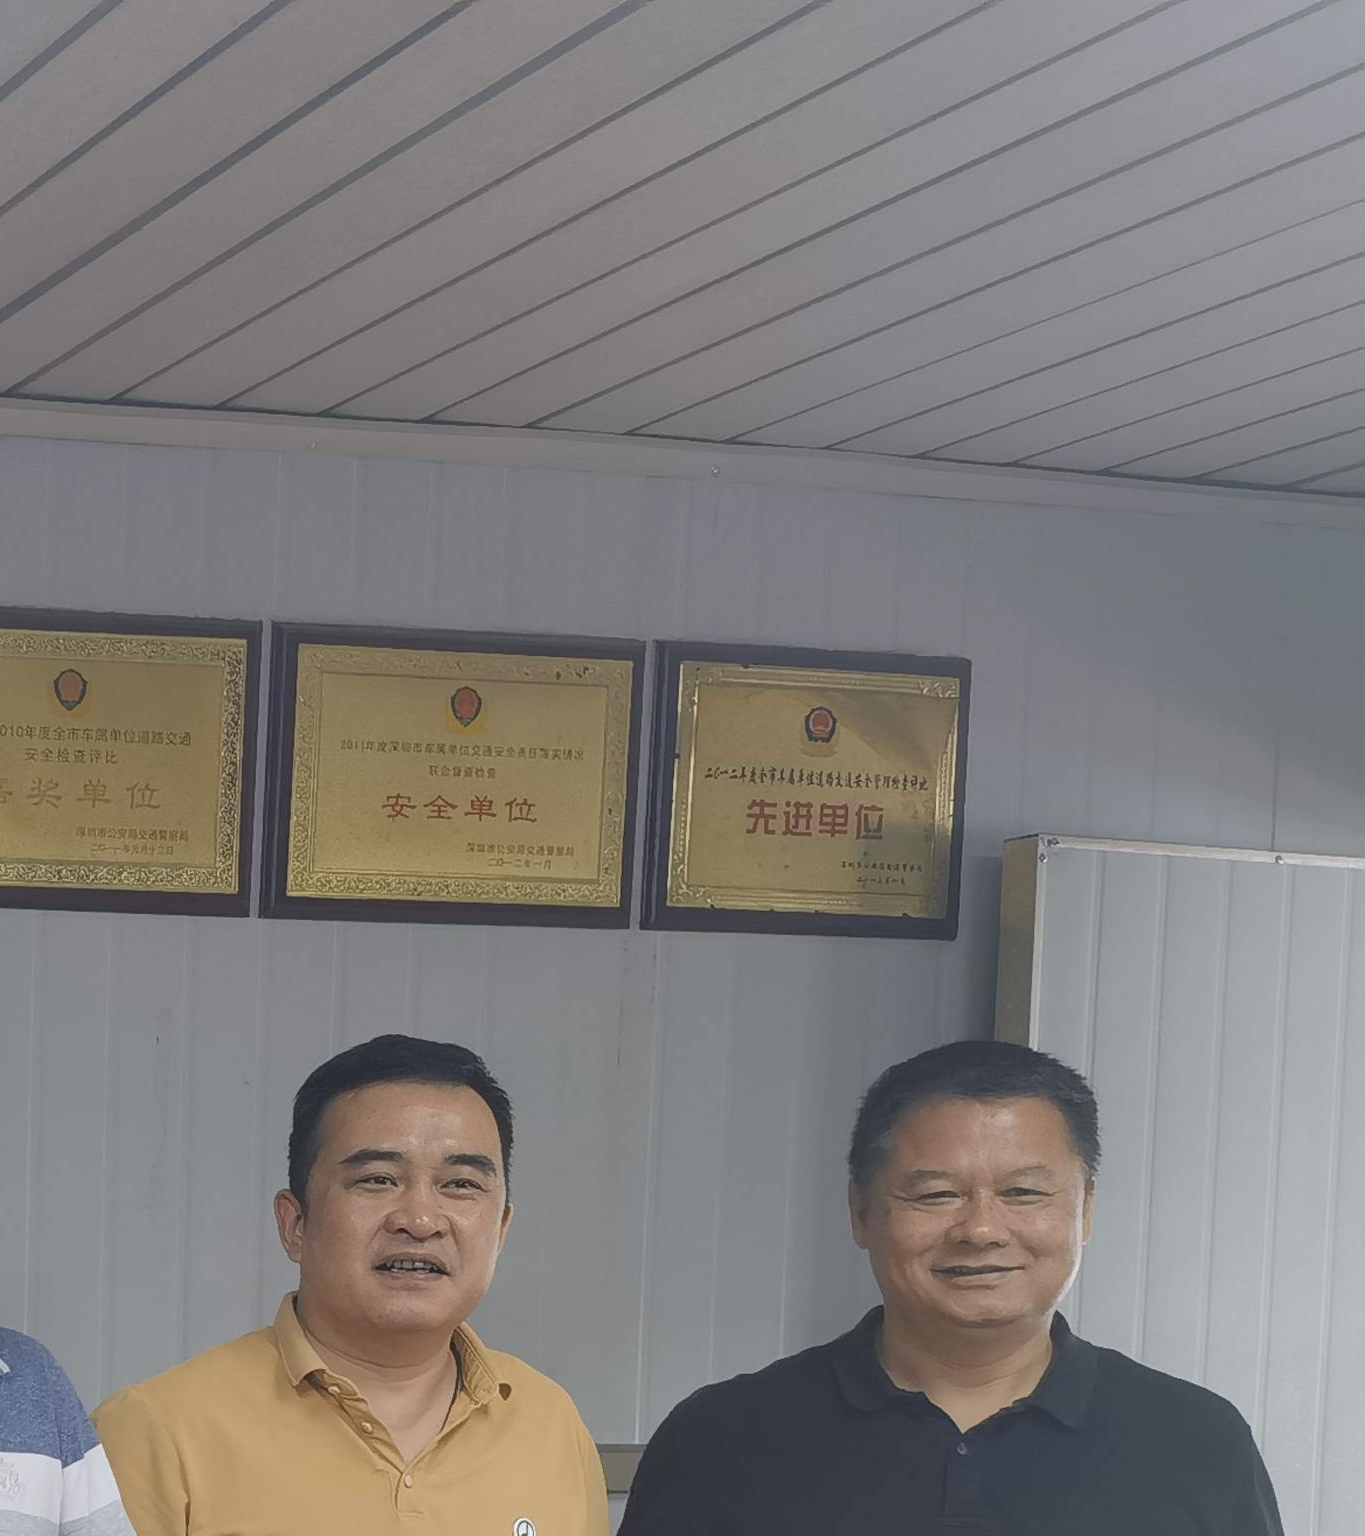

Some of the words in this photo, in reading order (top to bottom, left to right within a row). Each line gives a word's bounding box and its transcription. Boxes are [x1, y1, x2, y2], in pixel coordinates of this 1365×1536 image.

[381, 792, 537, 823] 安全单位
[746, 799, 885, 840] 先进单位
